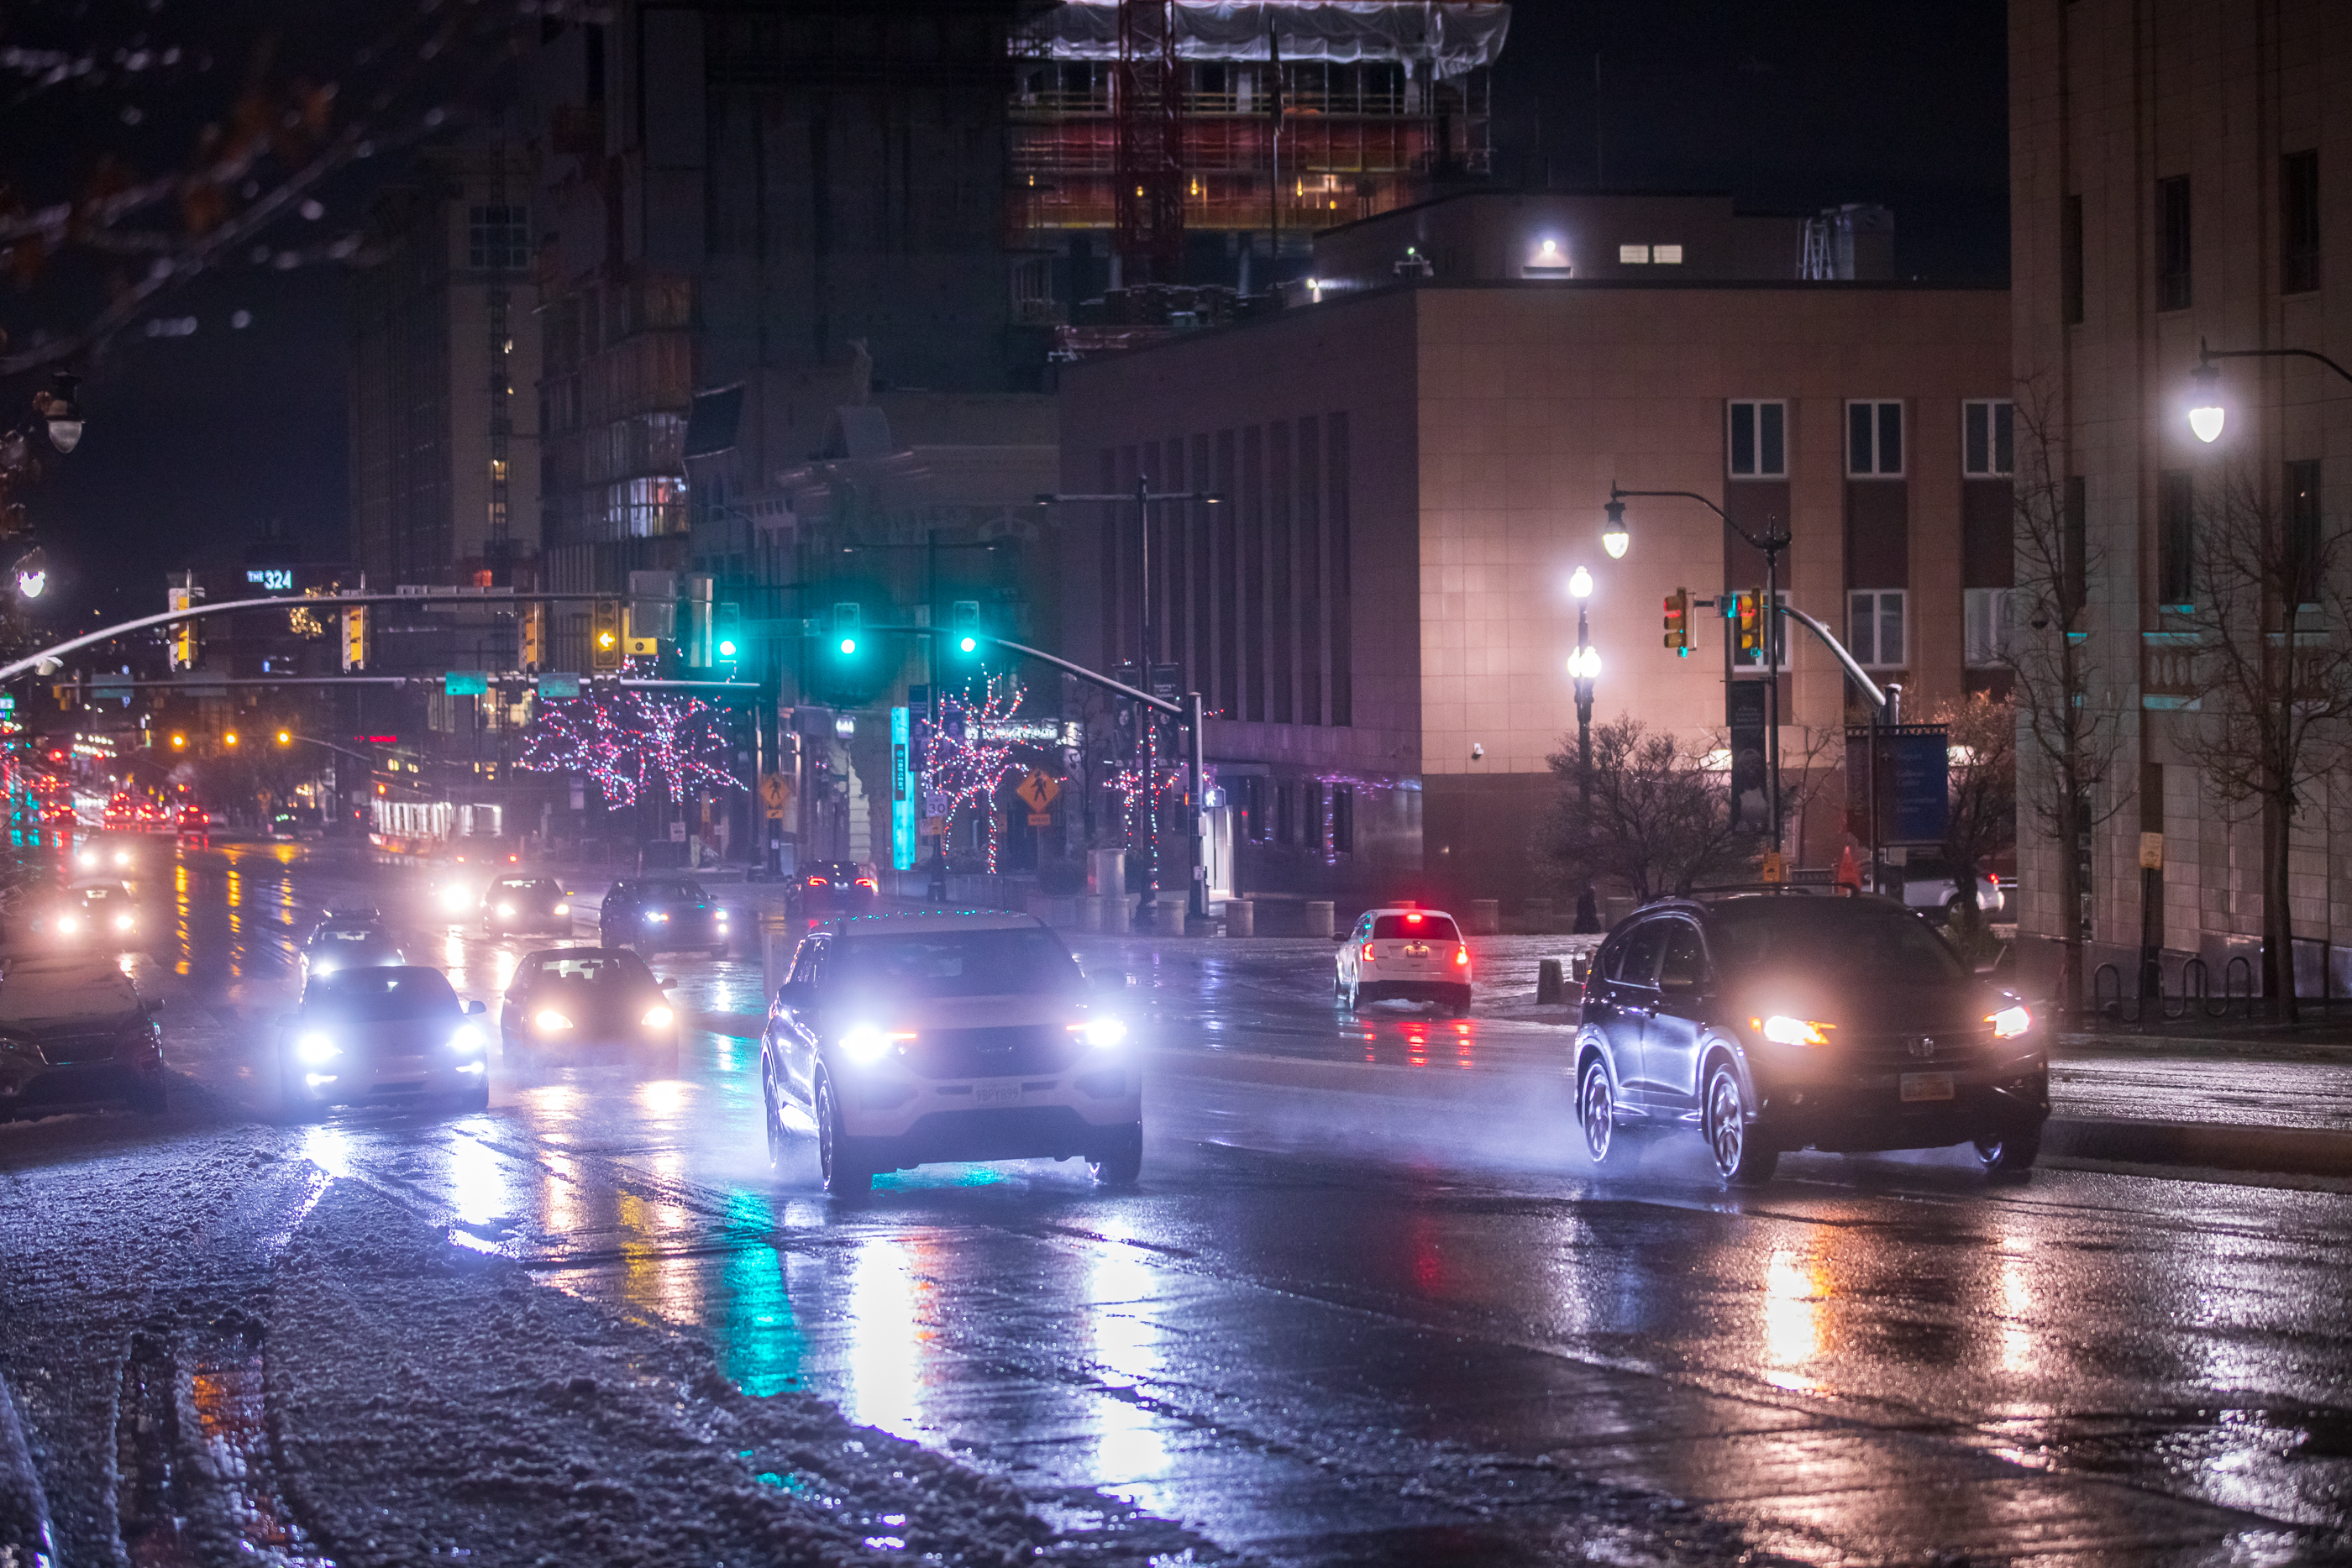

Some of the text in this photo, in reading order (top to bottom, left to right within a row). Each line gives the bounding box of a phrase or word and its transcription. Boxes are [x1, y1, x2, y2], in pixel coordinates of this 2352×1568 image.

[247, 569, 292, 590] THE 324
[928, 803, 945, 813] 30
